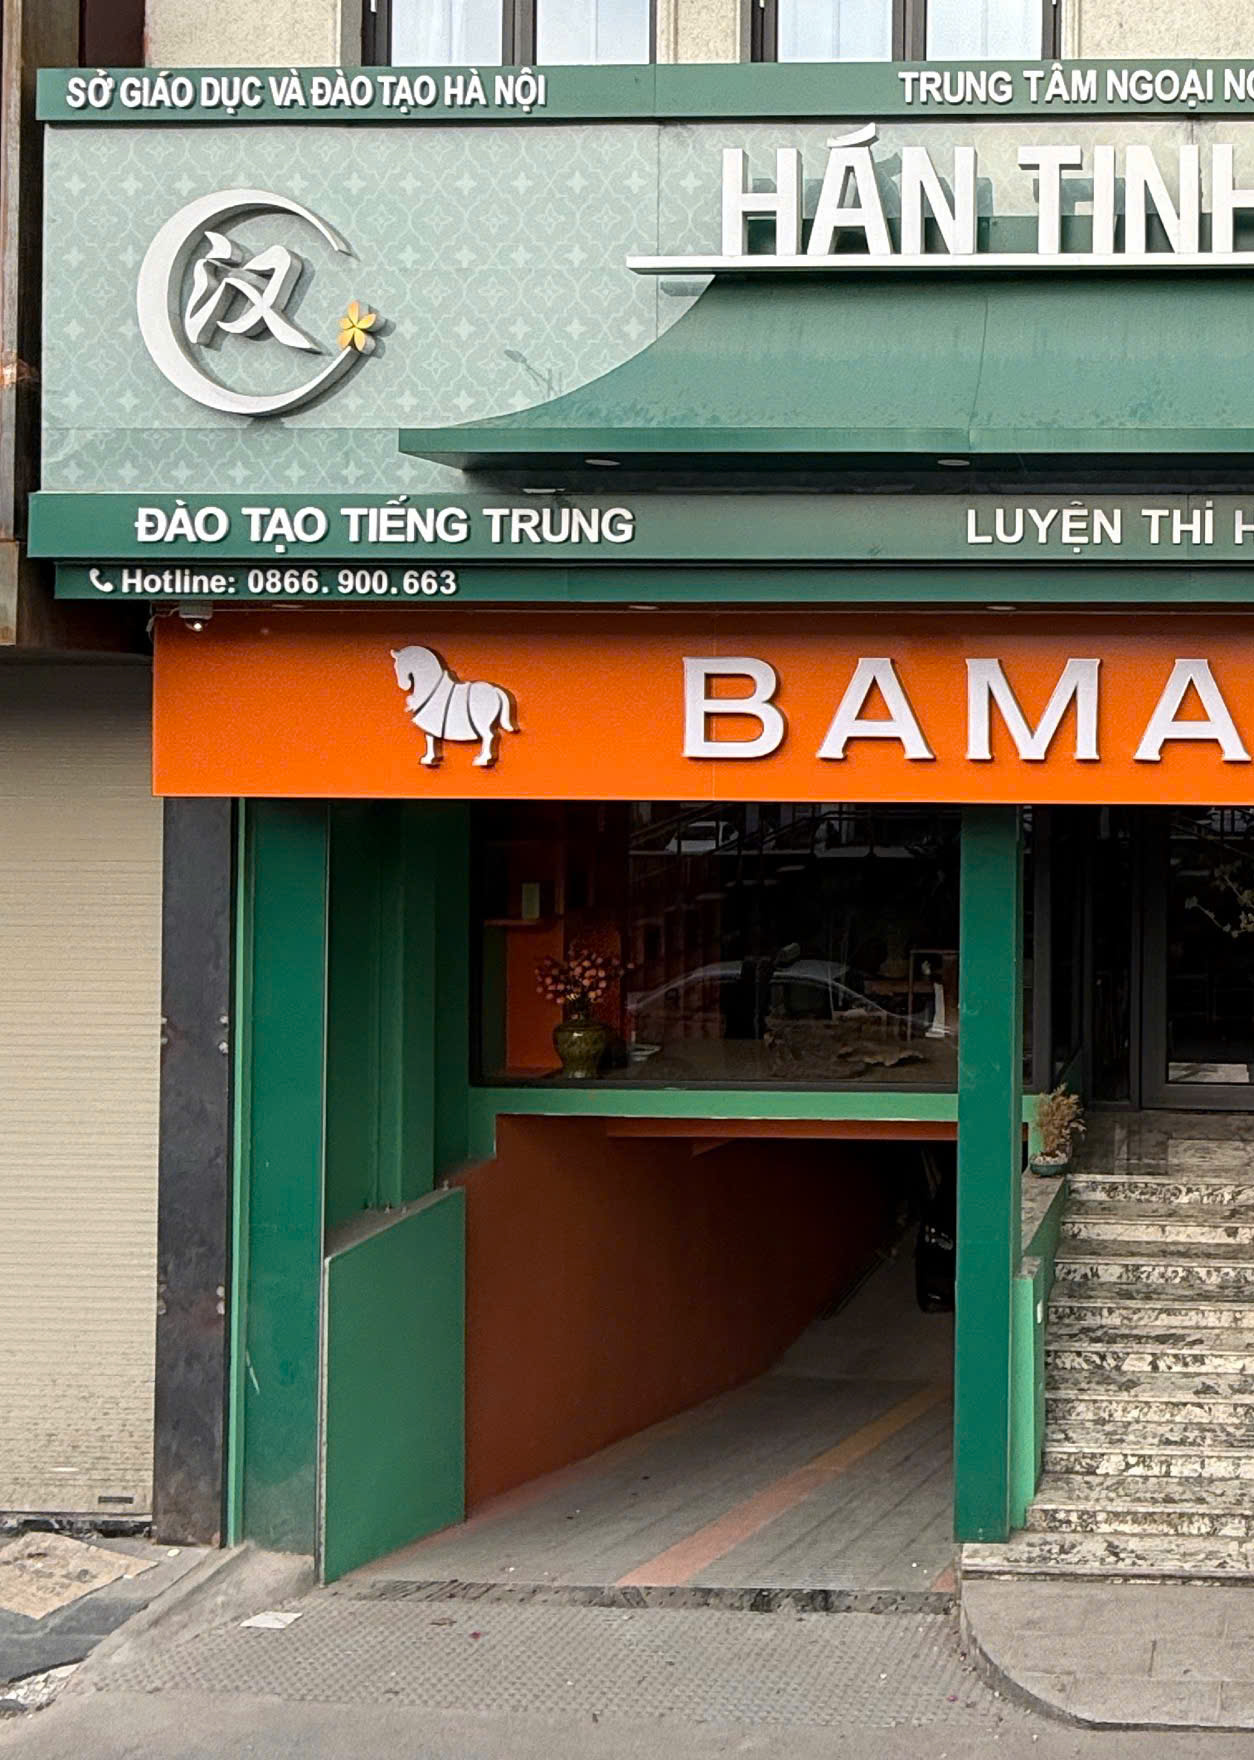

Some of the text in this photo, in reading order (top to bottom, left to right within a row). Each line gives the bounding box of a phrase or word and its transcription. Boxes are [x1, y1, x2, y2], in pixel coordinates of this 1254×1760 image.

[67, 67, 544, 113] SỞ GIÁO DỤC VÀ ĐÀO TẠO HÀ NỘI
[898, 71, 1012, 102] TRUNG
[1023, 63, 1096, 101] TÂM
[1107, 69, 1213, 106] NGOẠI
[719, 122, 978, 256] HÁN
[135, 496, 632, 552] ĐÀO TẠO TIẾNG TRUNG
[968, 501, 1121, 552] LUYỆN
[123, 571, 234, 592] Hotline:
[682, 657, 1252, 762] BAMA
